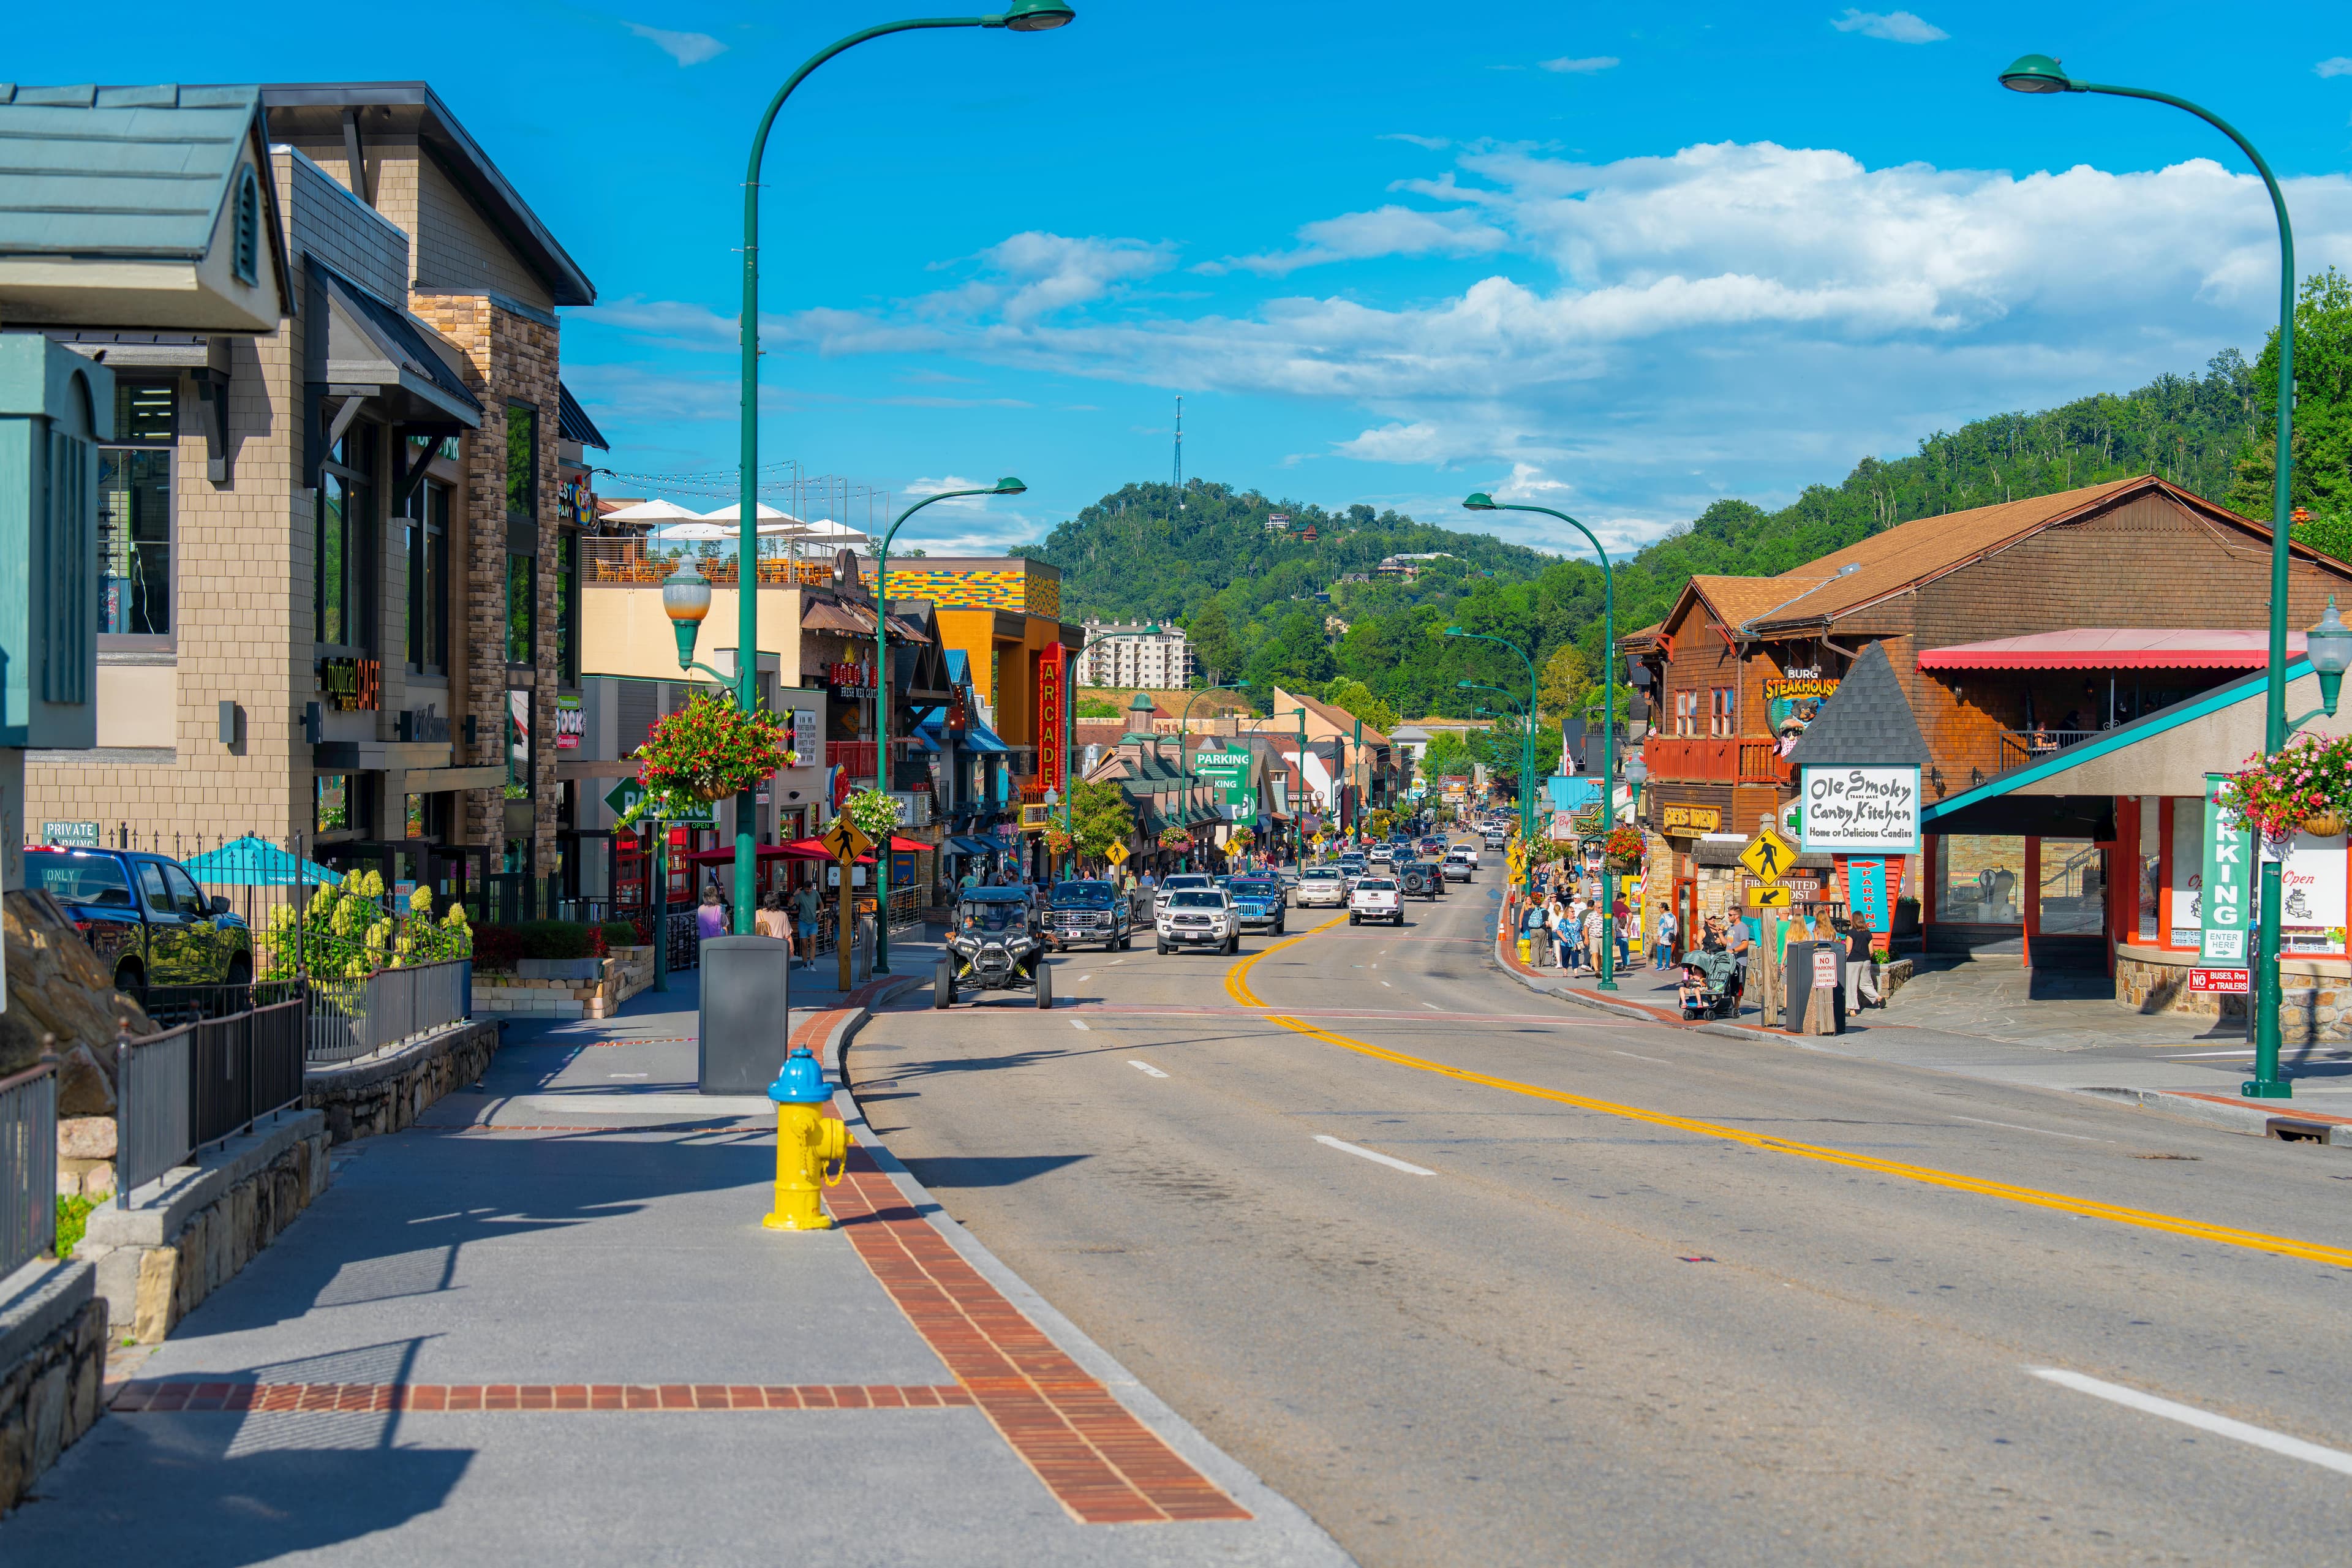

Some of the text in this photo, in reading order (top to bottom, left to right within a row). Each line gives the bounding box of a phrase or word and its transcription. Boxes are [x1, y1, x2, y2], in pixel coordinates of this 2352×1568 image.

[559, 480, 573, 501] EST
[558, 503, 573, 518] PANY
[831, 662, 860, 686] LOCO
[1789, 669, 1818, 679] BURG
[328, 657, 380, 711] tropical CAFE
[1766, 678, 1841, 699] STEAKHOUSE
[841, 687, 879, 698] FRESH MEX CANTI
[559, 698, 578, 707] Tennessee
[1044, 665, 1055, 783] ARCADE
[559, 737, 577, 746] Company
[1197, 754, 1249, 764] PARKING
[1811, 770, 1911, 806] Ole Smoky
[1811, 800, 1910, 829] Candy Kitchen
[47, 823, 94, 836] PRIVATE
[1809, 827, 1830, 837] Home
[1842, 827, 1879, 837] Delicious
[47, 870, 74, 881] ONLY
[2188, 873, 2203, 890] Op
[2282, 869, 2315, 887] Open
[1744, 879, 1818, 891] FIR UNITED
[1862, 870, 1877, 929] PARKING
[2192, 974, 2206, 986] NO
[2210, 971, 2233, 981] BUSES,
[2215, 982, 2247, 990] TRAILERS
